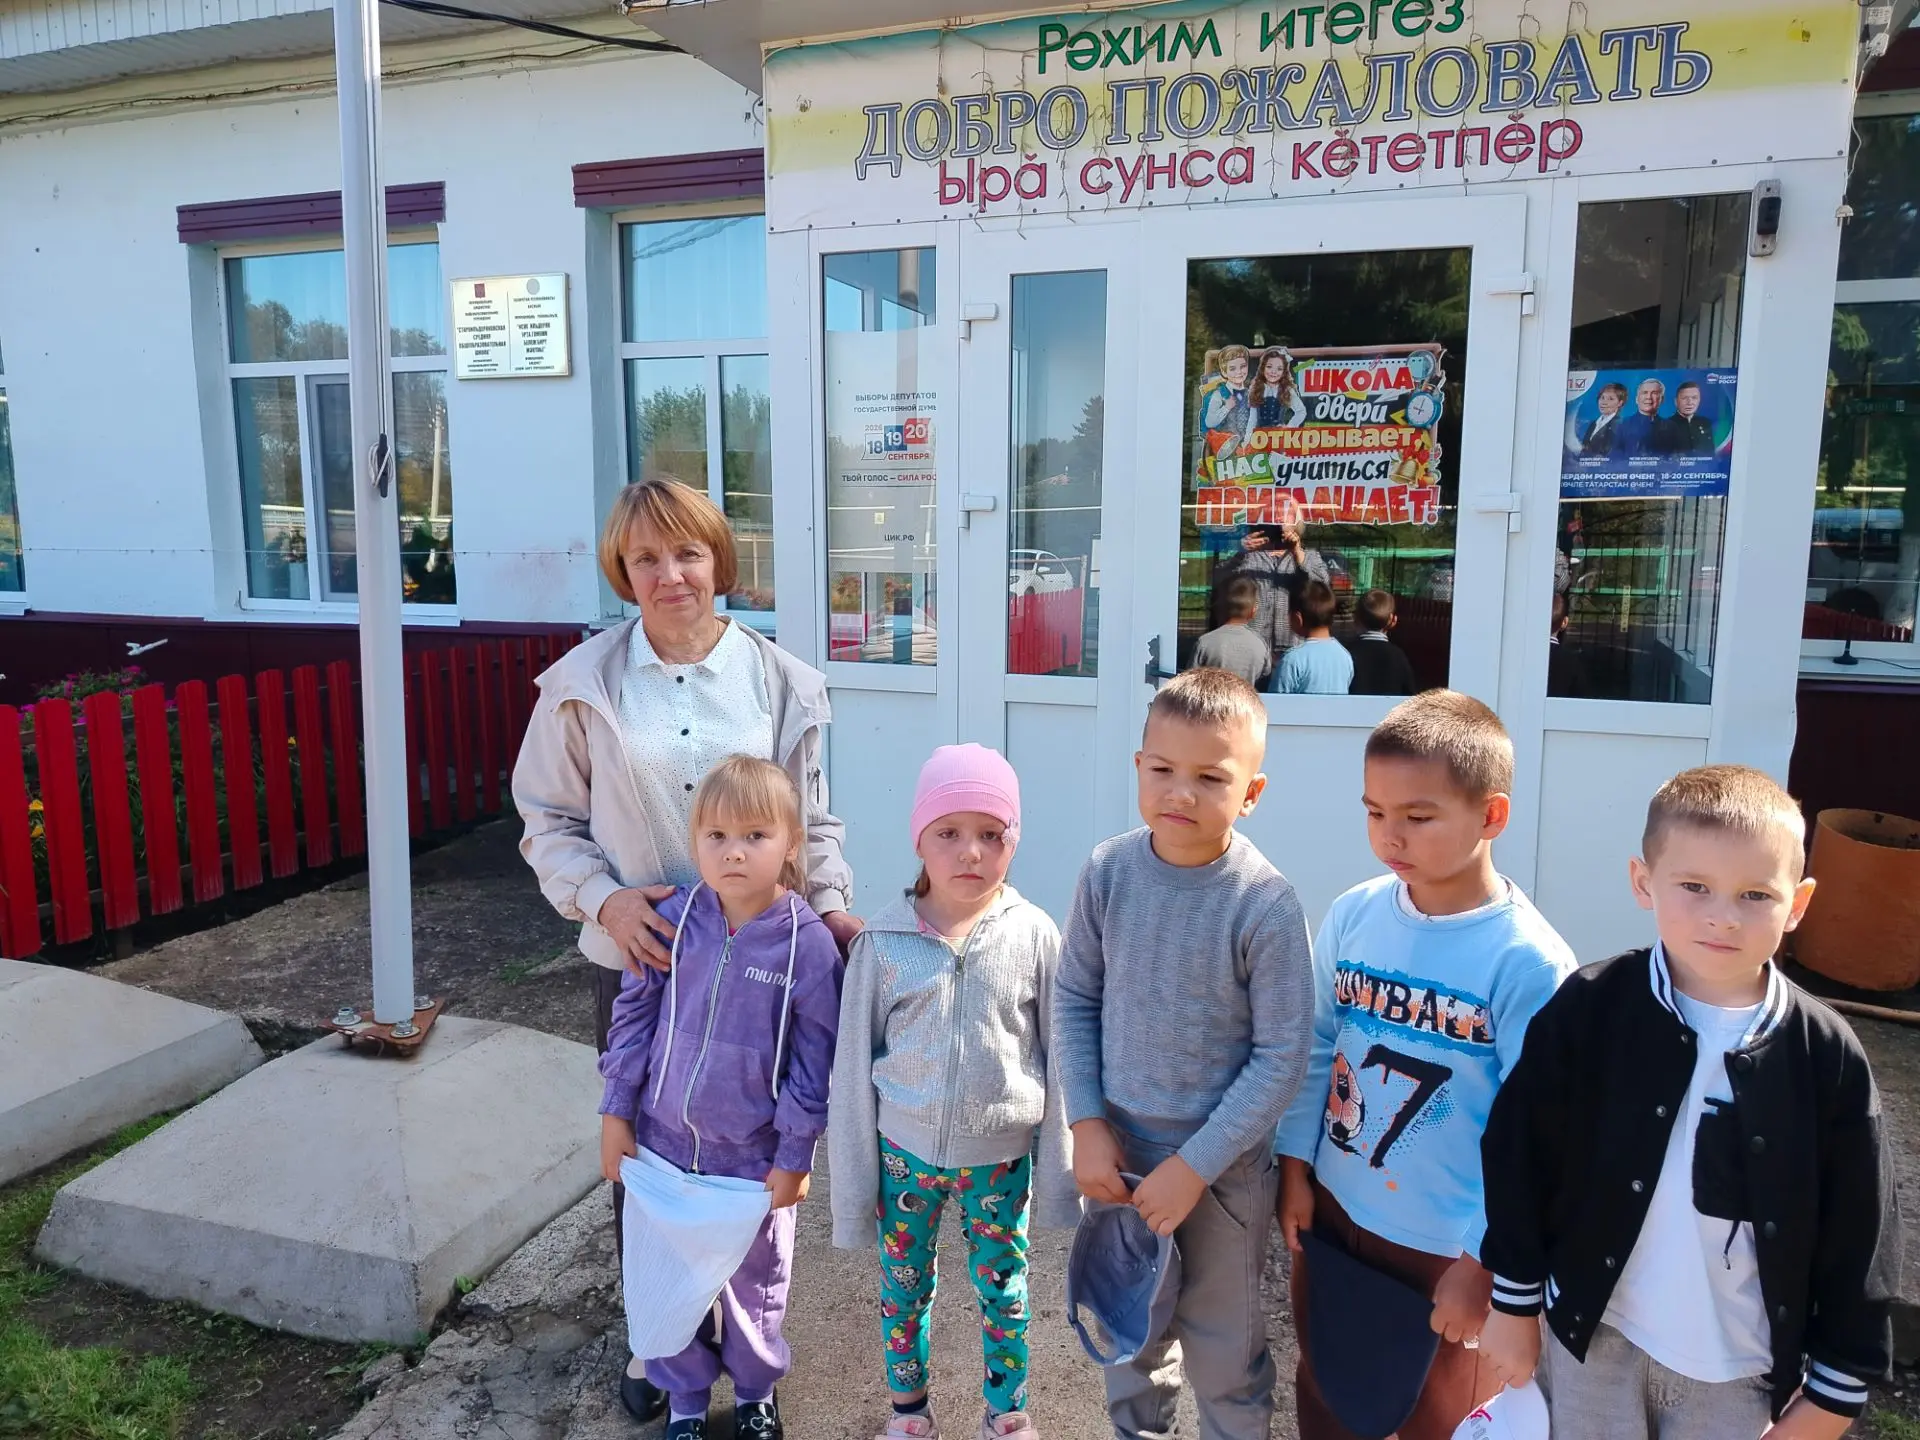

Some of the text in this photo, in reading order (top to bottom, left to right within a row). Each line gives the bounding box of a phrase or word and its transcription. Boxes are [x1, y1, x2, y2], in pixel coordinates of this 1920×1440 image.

[1260, 0, 1465, 52] итегез
[854, 21, 1712, 181] ДОБРО ПОЖАЛОВАТЬ
[1080, 146, 1254, 204] сунса
[1303, 366, 1415, 393] ШКОЛА
[854, 404, 917, 413] ГОСУДАРСТВЕННОЙ
[855, 392, 937, 401] ВЫБОРЫ ДЕПУТАТОВ
[1314, 394, 1388, 428] двери
[867, 424, 927, 455] 18 19 20
[1250, 427, 1424, 455] открывает,
[888, 452, 930, 460] СЕНТЯБРЯ
[1215, 453, 1392, 487] НАС учиться
[842, 473, 862, 482] ТВОЙ
[863, 474, 889, 482] ГОЛОС
[897, 474, 919, 482] СИЛА
[1585, 480, 1629, 488] ТАТАРСТАН
[1195, 484, 1441, 526] ПРИГЛАШАЕТ!
[1360, 1043, 1454, 1168] 7
